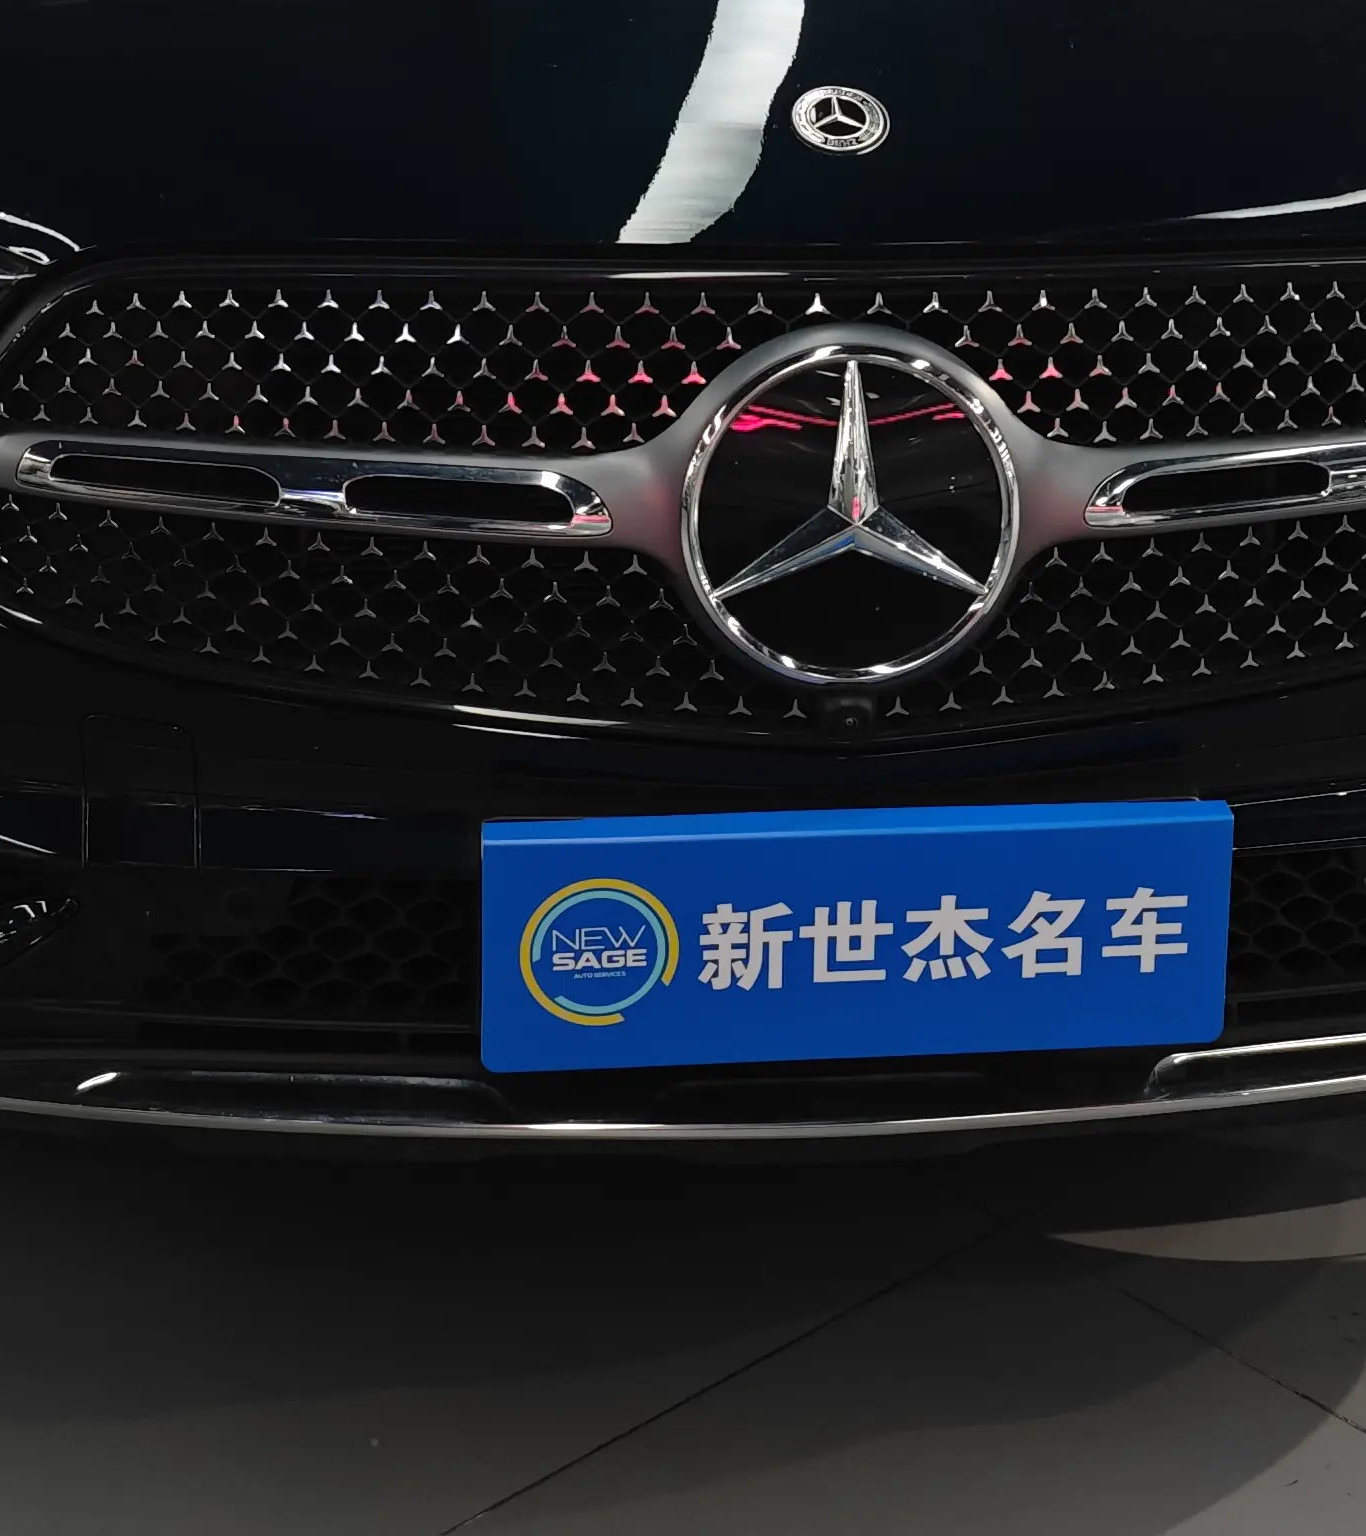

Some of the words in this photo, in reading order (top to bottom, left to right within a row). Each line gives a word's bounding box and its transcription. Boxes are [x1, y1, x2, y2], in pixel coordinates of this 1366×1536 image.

[552, 924, 647, 952] NEW
[697, 887, 1191, 992] 新世杰名车
[552, 948, 647, 971] SAGE
